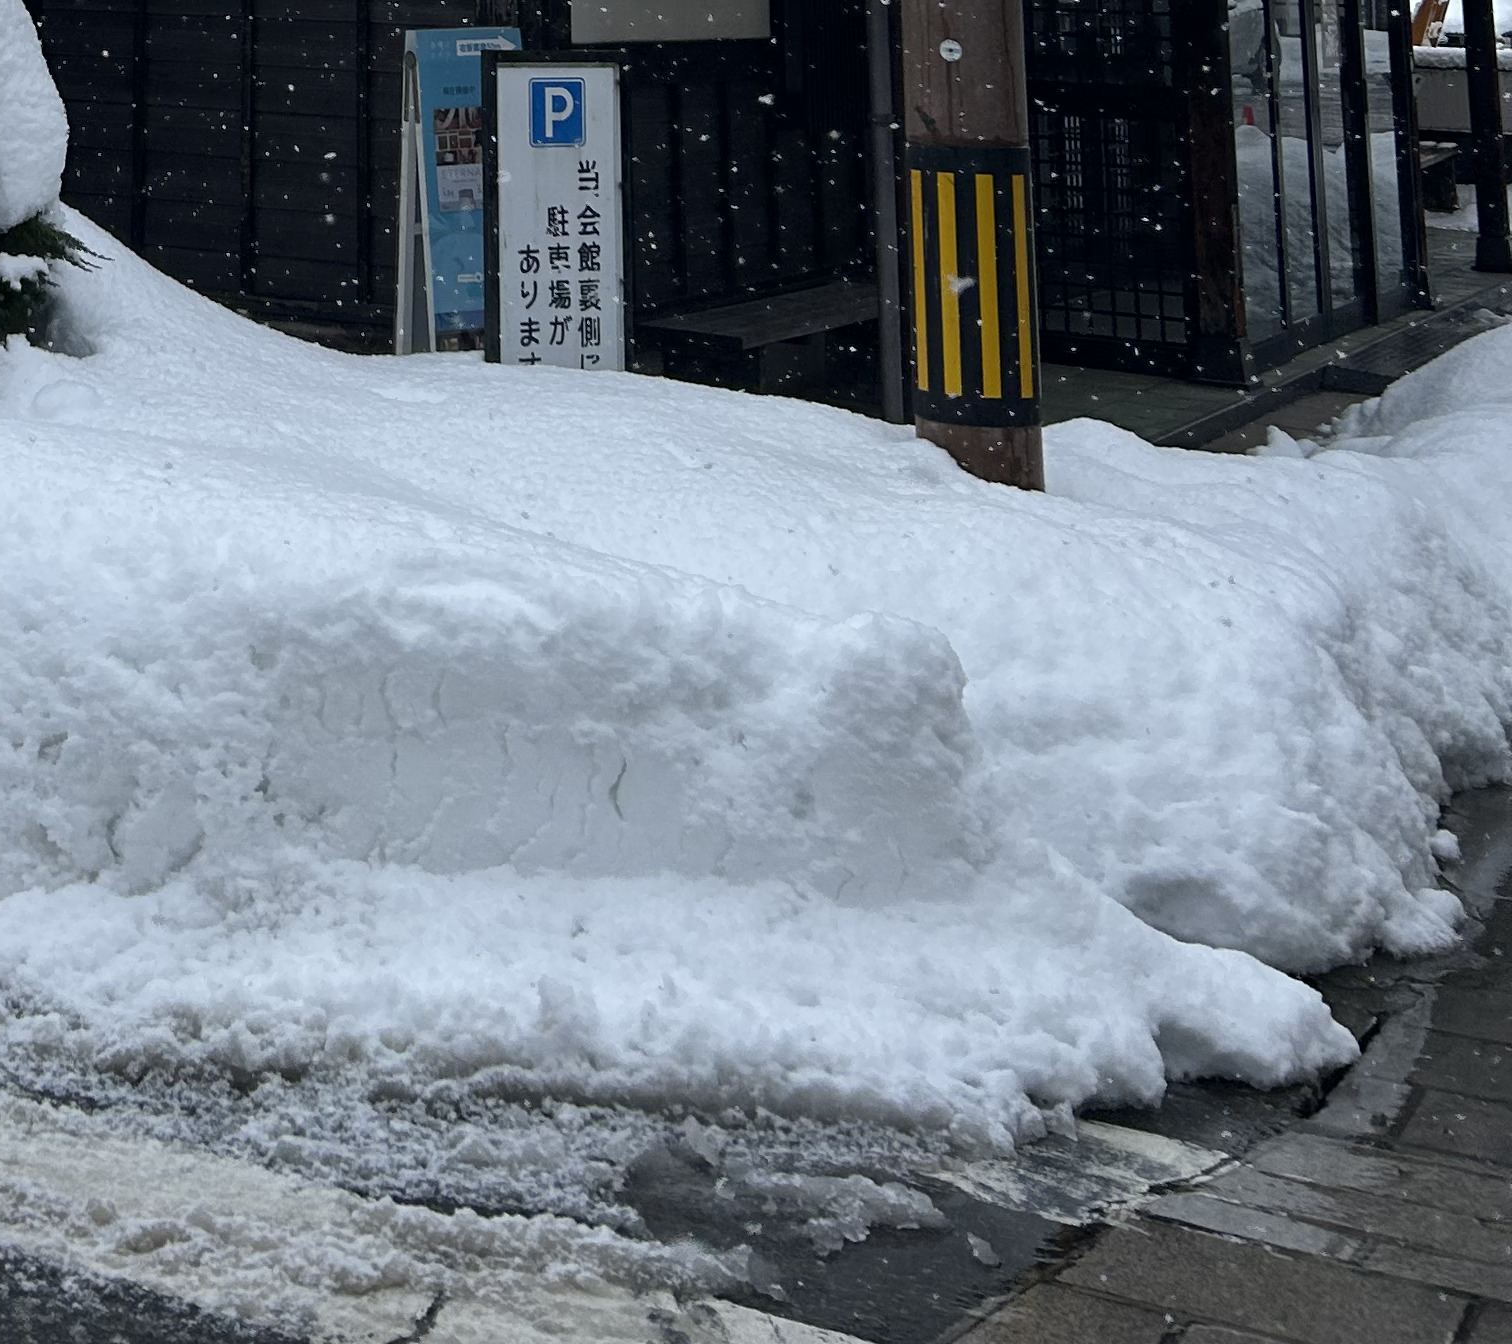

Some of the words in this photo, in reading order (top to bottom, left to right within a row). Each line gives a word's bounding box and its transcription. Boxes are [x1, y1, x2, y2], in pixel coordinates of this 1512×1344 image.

[544, 87, 574, 139] P
[545, 204, 573, 346] 駐車場が
